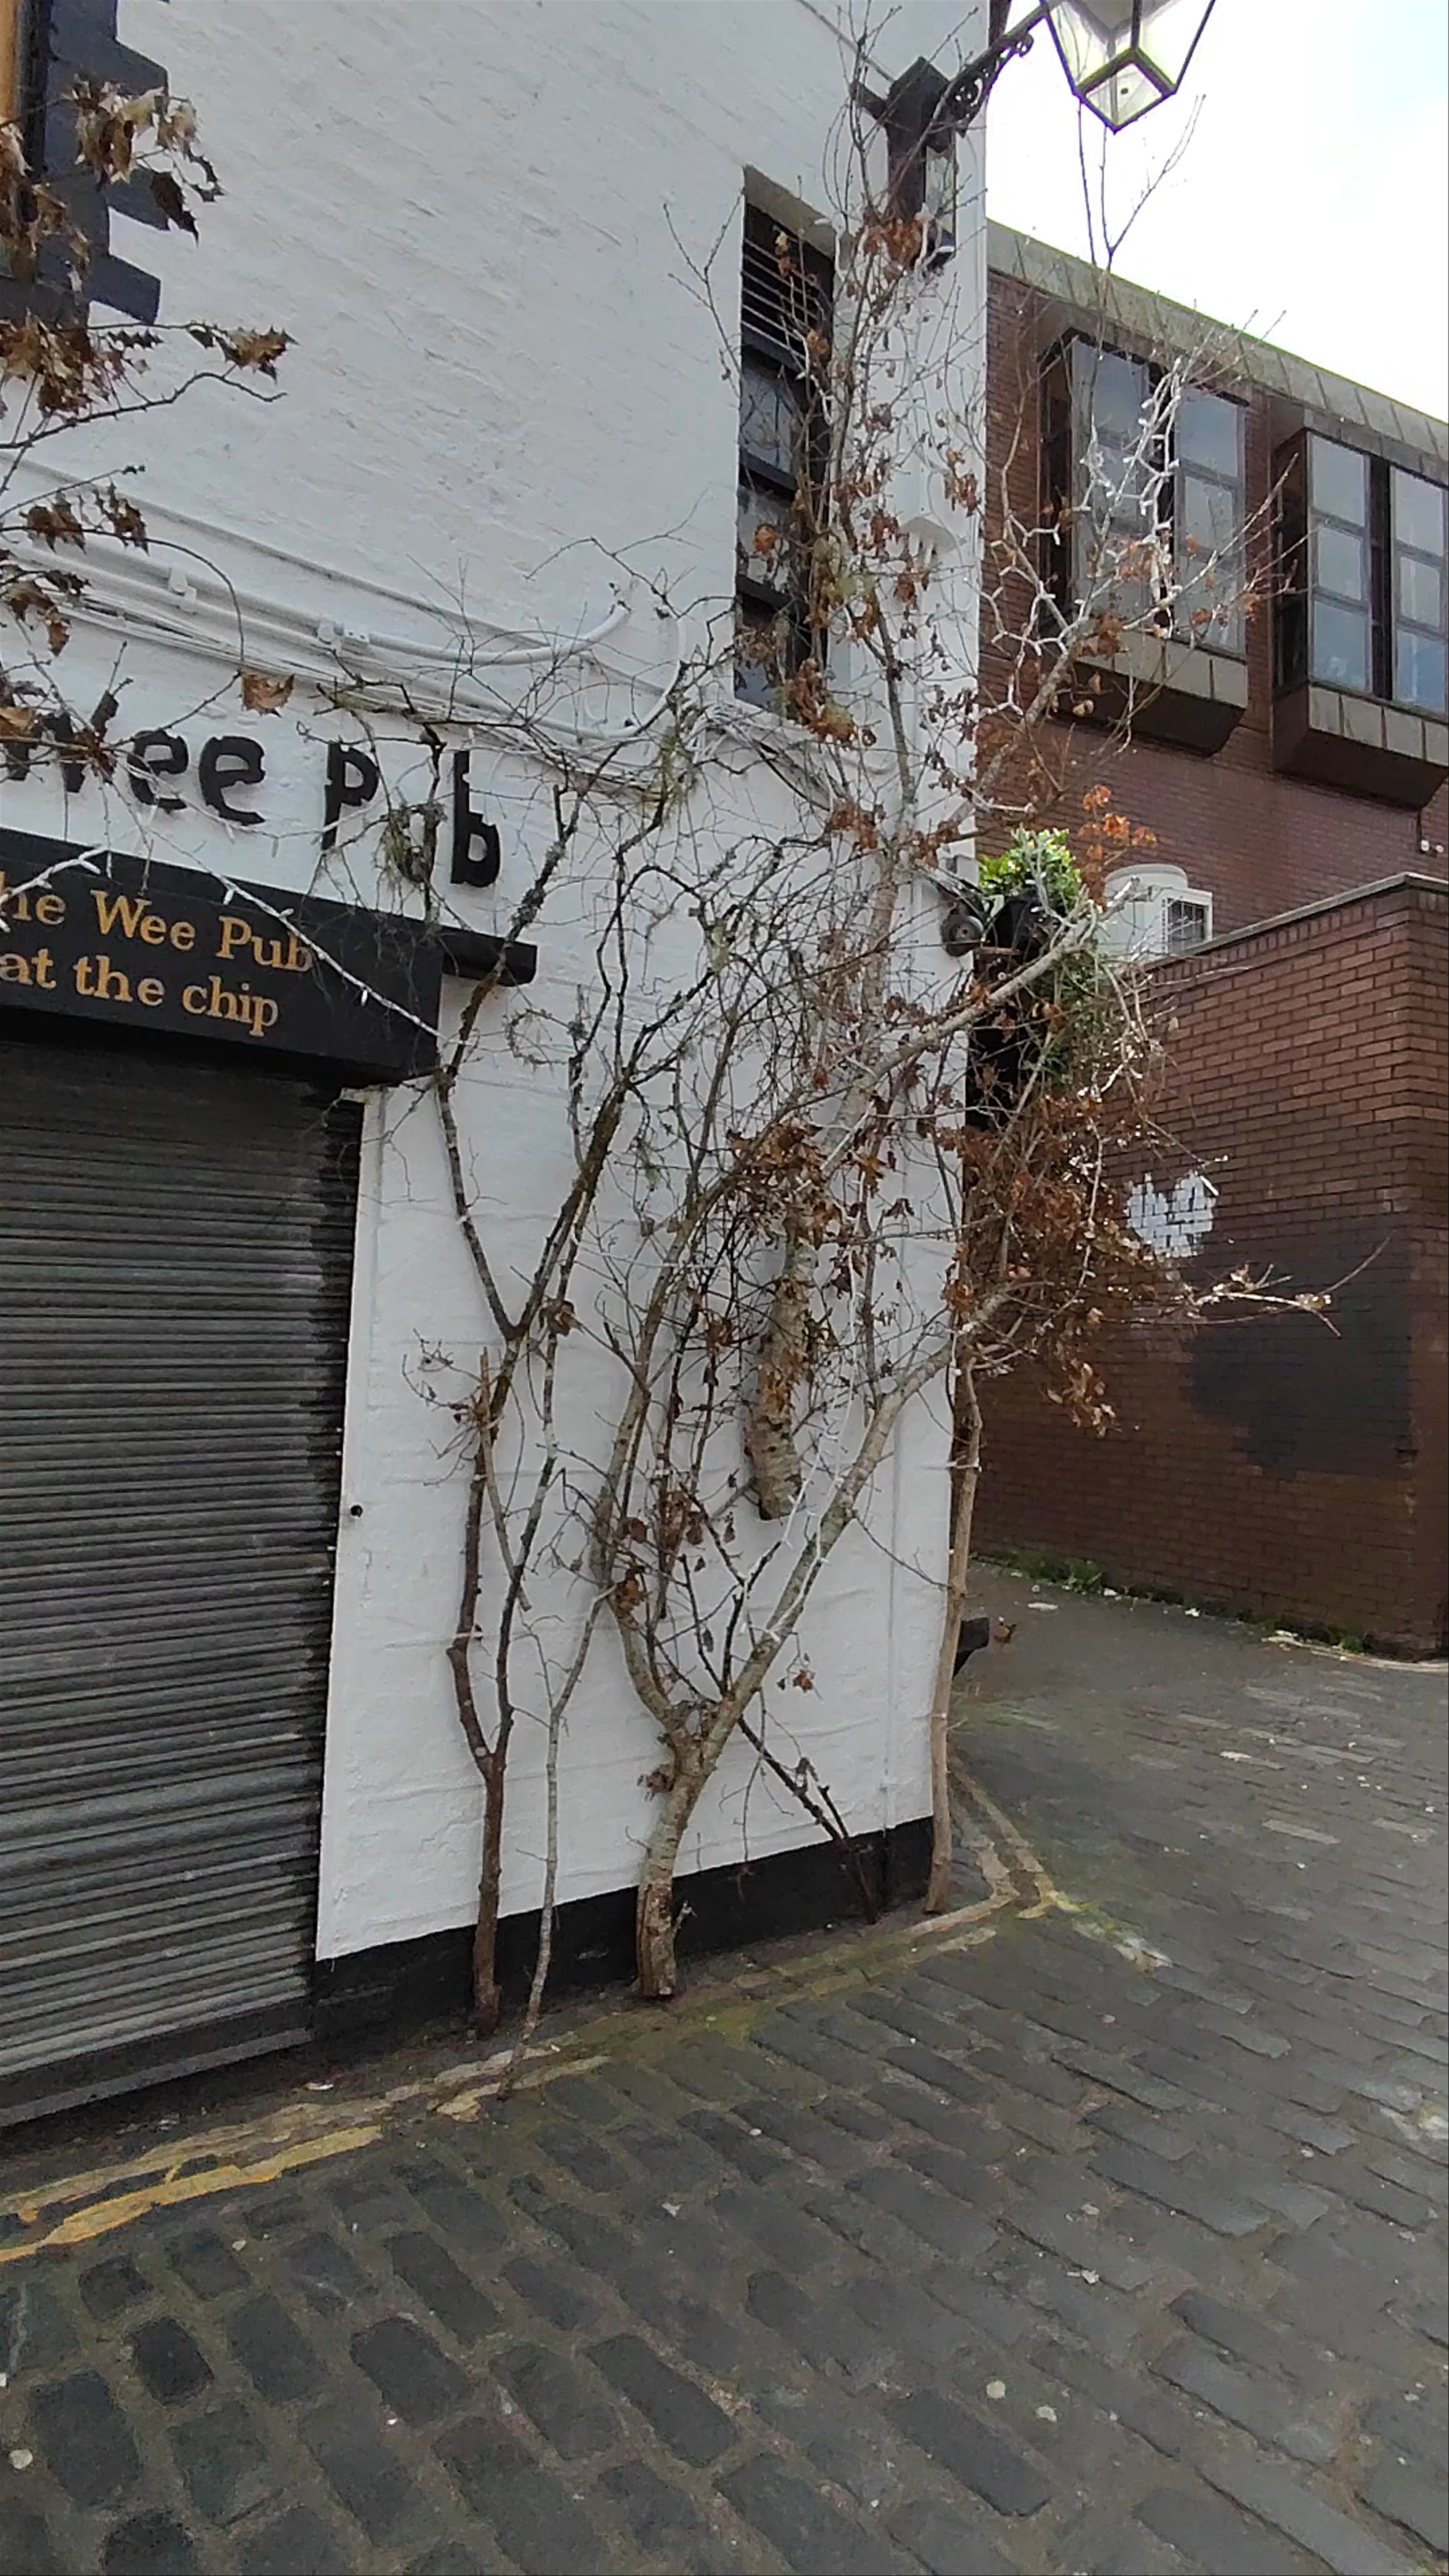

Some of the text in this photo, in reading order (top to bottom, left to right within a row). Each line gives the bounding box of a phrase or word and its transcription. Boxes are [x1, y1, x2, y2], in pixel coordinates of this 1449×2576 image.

[90, 889, 195, 950] Wee
[215, 915, 313, 972] Pub
[0, 948, 278, 1037] at the chip
